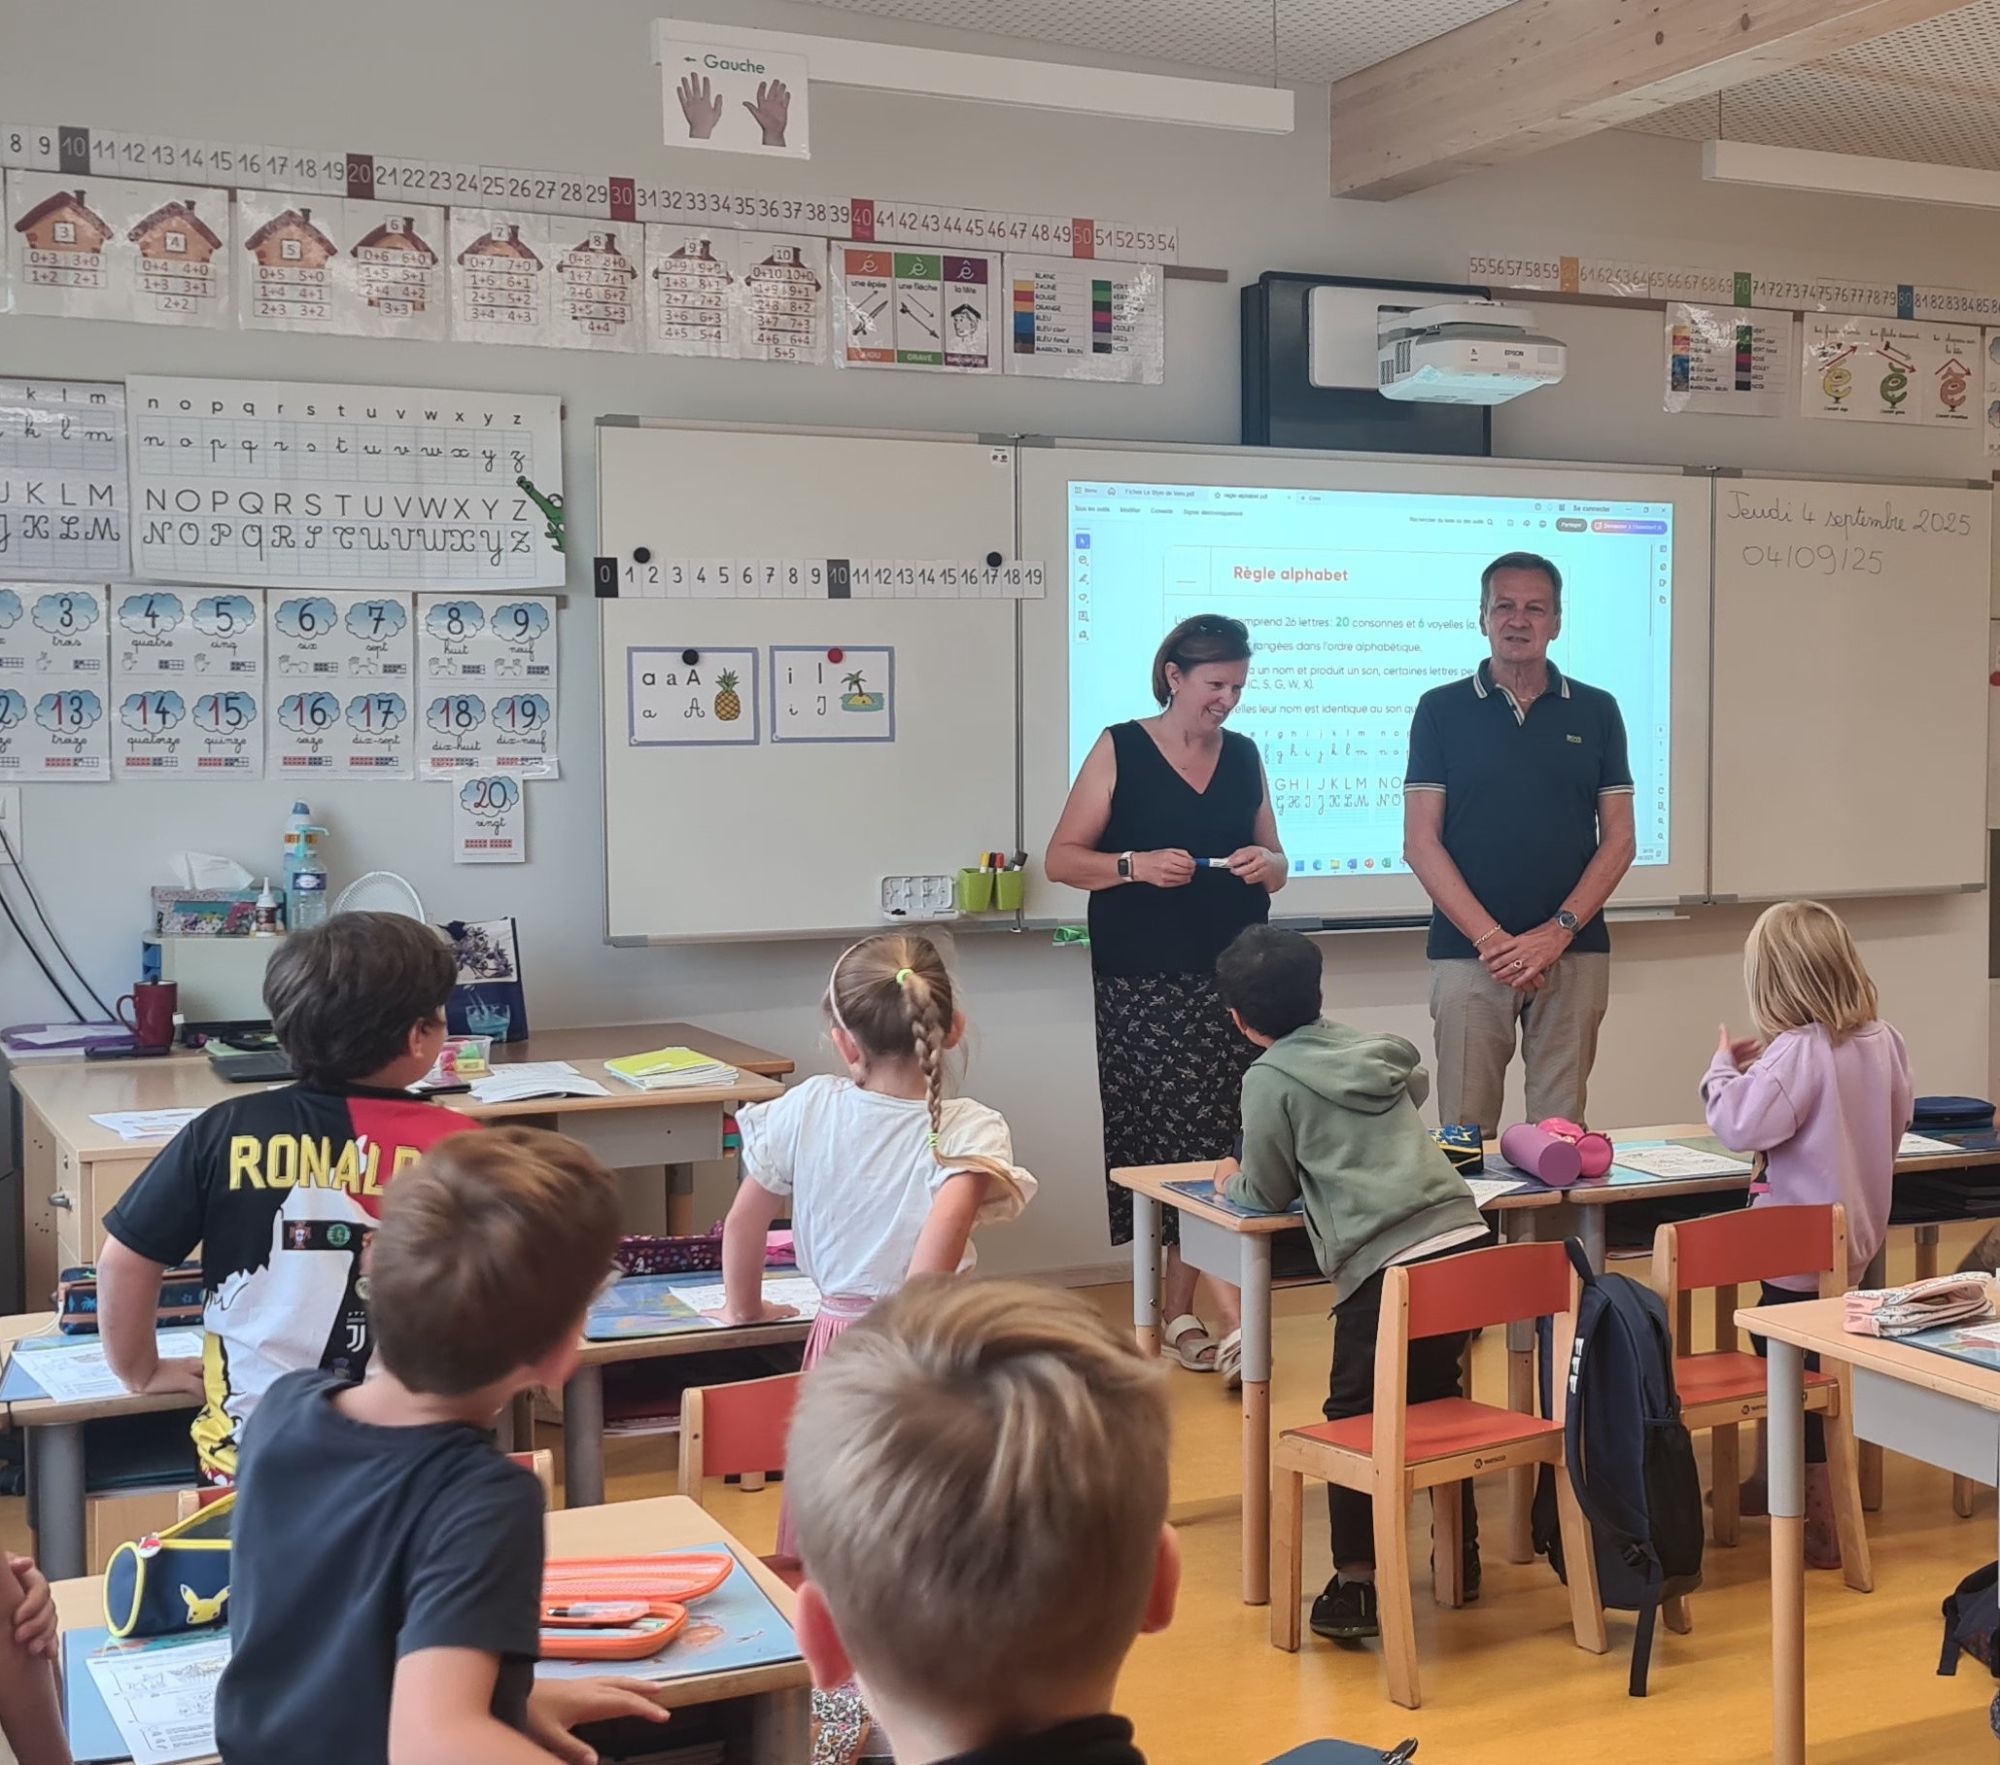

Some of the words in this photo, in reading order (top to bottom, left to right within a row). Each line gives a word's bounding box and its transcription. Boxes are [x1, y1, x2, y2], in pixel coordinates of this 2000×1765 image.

[704, 54, 765, 73] Gauche
[10, 134, 22, 152] 8
[39, 136, 50, 155] 9
[61, 137, 87, 157] 10
[93, 140, 114, 158] 11
[123, 143, 144, 162] 12
[152, 146, 174, 165] 13
[181, 149, 202, 166] 14
[210, 151, 232, 170] 15
[239, 154, 260, 173] 16
[267, 157, 288, 174] 17
[295, 159, 316, 178] 18
[323, 162, 344, 180] 19
[1096, 229, 1112, 246] 51
[1117, 231, 1134, 248] 52
[1138, 233, 1154, 250] 53
[1158, 234, 1174, 251] 54
[30, 251, 57, 263] 0+3
[73, 254, 100, 267] 3+0
[776, 249, 791, 260] 10
[753, 267, 781, 279] 0+10
[786, 270, 814, 281] 10+0
[860, 254, 878, 273] é
[908, 257, 927, 276] è
[957, 260, 974, 279] ê
[32, 270, 58, 283] 1+2
[73, 272, 98, 286] 2+1
[1470, 257, 1486, 274] 55
[1488, 258, 1504, 275] 56
[1506, 260, 1522, 276] 57
[1526, 262, 1540, 278] 58
[1544, 263, 1559, 279] 59
[1753, 280, 1765, 295] 71
[1768, 282, 1783, 298] 72
[1786, 283, 1800, 298] 73
[261, 303, 286, 315] 2+3
[300, 304, 324, 317] 3+2
[384, 302, 408, 314] 3+3
[774, 347, 796, 359] 5+5
[1504, 349, 1524, 357] EPSON
[148, 399, 158, 408] n
[180, 400, 191, 410] o
[212, 402, 223, 414] p
[243, 403, 254, 416] q
[278, 404, 283, 414] r
[307, 406, 315, 416] s
[338, 405, 344, 416] t
[367, 408, 376, 418] u
[396, 410, 405, 419] v
[425, 411, 437, 420] w
[456, 412, 464, 422] x
[484, 414, 493, 426] y
[514, 415, 521, 424] z
[147, 488, 166, 510] N
[176, 489, 200, 512] O
[212, 490, 228, 512] P
[239, 492, 264, 514] Q
[275, 493, 292, 514] R
[305, 494, 321, 516] S
[335, 494, 352, 516] T
[365, 496, 382, 518] U
[394, 496, 412, 518] V
[418, 497, 447, 518] W
[454, 498, 470, 520] X
[482, 499, 498, 520] Y
[512, 500, 527, 521] Z
[1727, 491, 1792, 522] Jeudi
[1803, 503, 1816, 524] 4
[1824, 501, 1906, 540] septembre
[1912, 509, 1971, 536] 2025
[1743, 545, 1883, 575] 04/09/25
[600, 565, 610, 583] 0
[626, 566, 633, 582] 1
[648, 566, 658, 583] 2
[673, 566, 682, 583] 3
[697, 567, 706, 583] 4
[719, 566, 728, 584] 5
[743, 567, 752, 584] 6
[766, 567, 774, 584] 7
[789, 567, 798, 584] 8
[812, 568, 820, 584] 9
[830, 567, 847, 584] 10
[1234, 565, 1275, 583] Règle
[1281, 566, 1348, 582] alphabet
[60, 597, 73, 627] 3
[144, 600, 159, 628] 4
[215, 601, 233, 632] 5
[298, 602, 315, 632] 6
[368, 606, 386, 634] 7
[447, 607, 464, 635] 8
[1336, 616, 1350, 628] 20
[1352, 620, 1403, 628] consonnes
[1406, 619, 1416, 628] et
[1418, 618, 1425, 628] 6
[1427, 619, 1464, 630] voyelles
[52, 636, 82, 647] trois
[131, 636, 173, 654] quatre
[444, 638, 468, 654] huit
[1253, 642, 1294, 653] rangées
[1296, 642, 1320, 651] dans
[642, 672, 655, 686] a
[666, 672, 677, 686] a
[686, 669, 701, 686] A
[787, 667, 793, 684] i
[1258, 667, 1270, 675] un
[1272, 667, 1295, 675] nom
[1297, 666, 1307, 675] et
[1310, 666, 1344, 678] produit
[1348, 667, 1360, 675] un
[1384, 666, 1427, 676] certaines
[1429, 666, 1458, 676] lettres
[51, 695, 83, 725] 13
[136, 696, 170, 725] 14
[209, 696, 242, 726] 15
[293, 696, 326, 726] 16
[361, 698, 394, 727] 17
[440, 699, 472, 728] 18
[684, 698, 705, 719] A
[1259, 704, 1277, 714] leur
[1280, 705, 1302, 714] nom
[1304, 705, 1319, 714] est
[1322, 704, 1368, 715] identique
[1370, 706, 1383, 714] au
[1385, 706, 1402, 714] son
[127, 733, 180, 753] quatorze
[204, 736, 247, 754] quinze
[473, 781, 507, 808] 20
